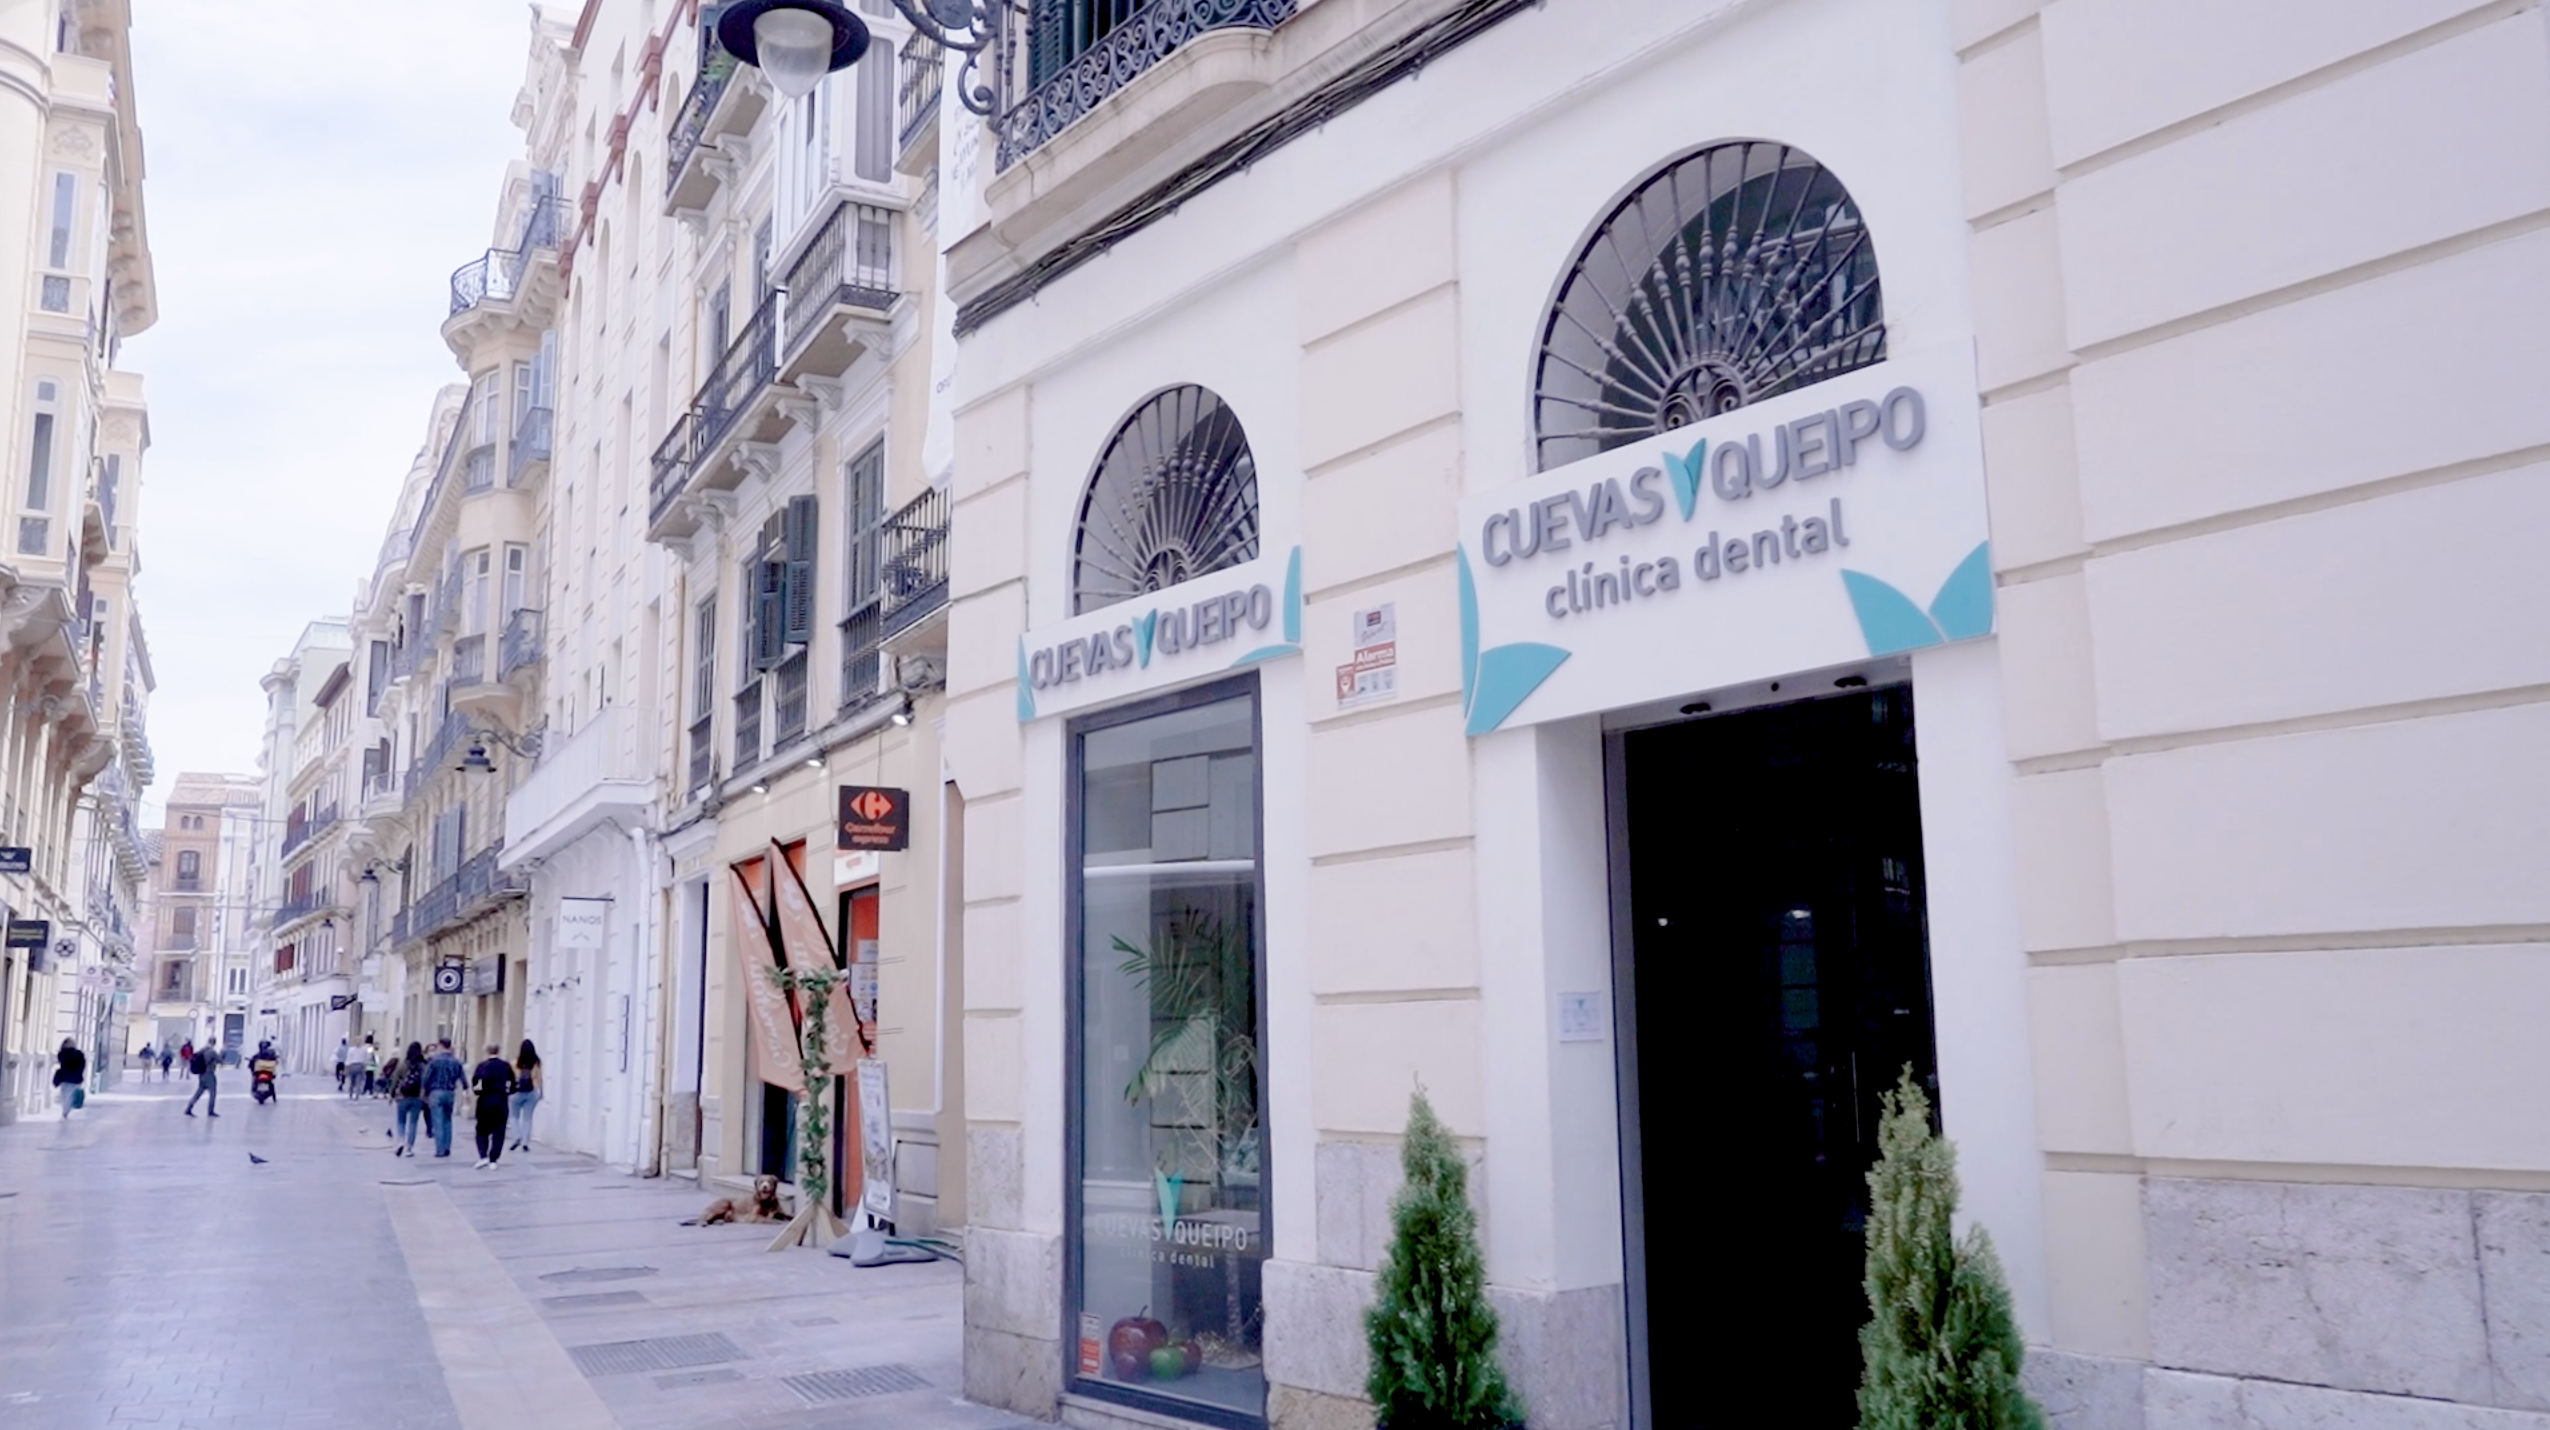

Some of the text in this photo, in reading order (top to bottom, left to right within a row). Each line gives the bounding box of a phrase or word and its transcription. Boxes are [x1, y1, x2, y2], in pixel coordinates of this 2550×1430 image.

[1482, 466, 1664, 567] CUEVAS
[1711, 386, 1925, 501] QUEIPO
[1545, 497, 1850, 619] clínica dental
[1030, 625, 1132, 689] CUEVAS
[1158, 584, 1271, 654] QUEIPO
[562, 915, 602, 925] NANOS
[1170, 1250, 1214, 1269] dental
[1174, 1220, 1248, 1251] QUEIPO
